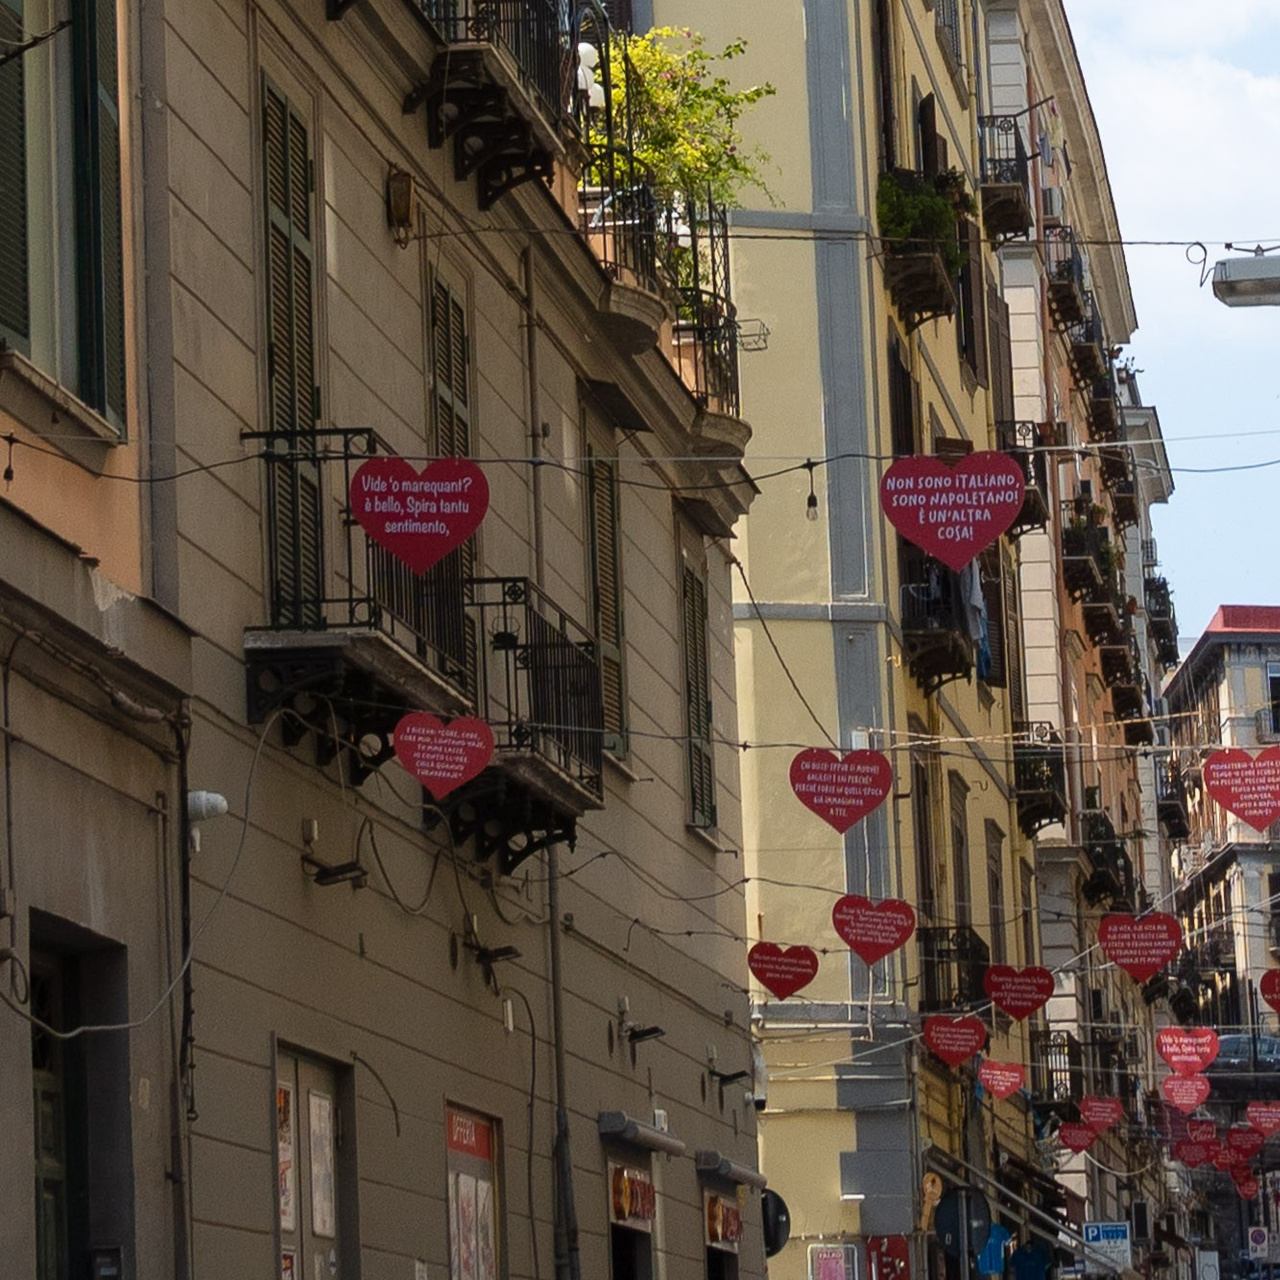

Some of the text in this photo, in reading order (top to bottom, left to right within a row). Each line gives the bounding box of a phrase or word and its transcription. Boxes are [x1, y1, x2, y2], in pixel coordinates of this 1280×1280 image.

[361, 475, 387, 492] Vide
[886, 476, 914, 490] NON
[918, 476, 951, 488] SONO
[375, 496, 404, 516] bello,
[407, 496, 436, 517] Spira
[892, 491, 1018, 506] SONO NAPOLETANO!
[919, 508, 925, 524] È
[385, 520, 450, 536] sentimento,
[938, 526, 974, 541] COSA!
